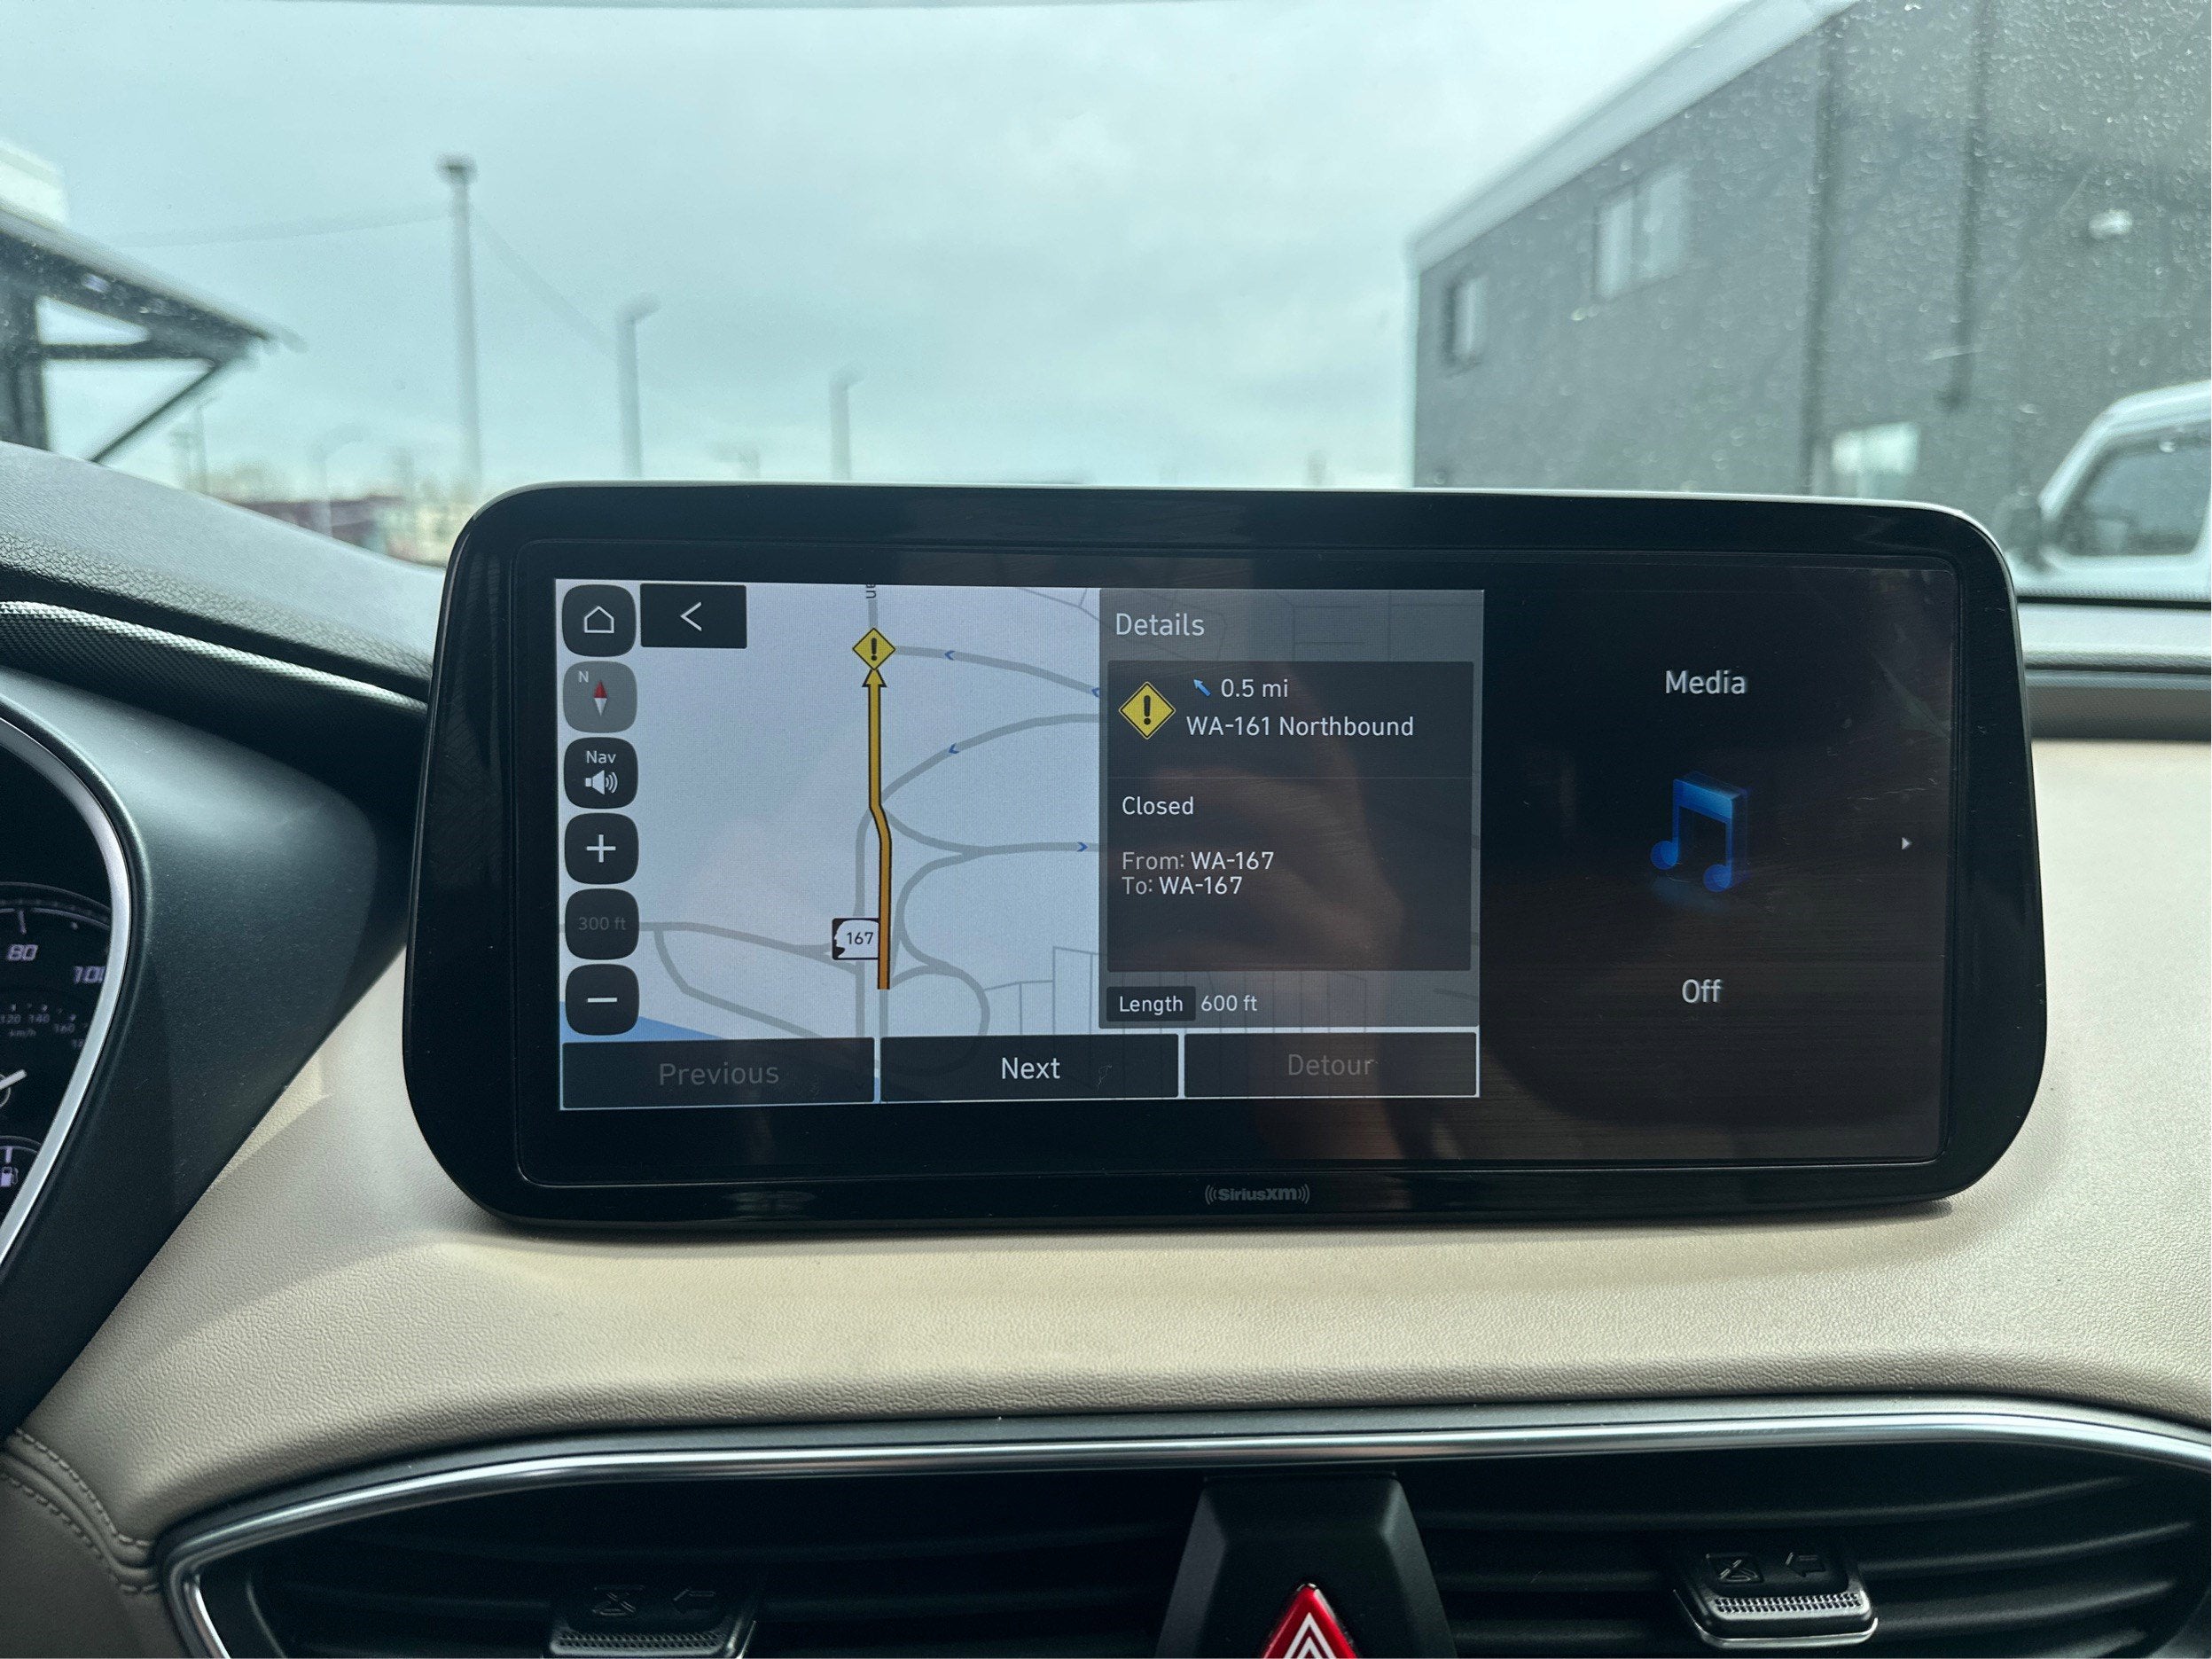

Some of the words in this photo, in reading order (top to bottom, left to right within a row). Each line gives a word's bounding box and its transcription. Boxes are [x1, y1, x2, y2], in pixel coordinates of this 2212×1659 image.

[1114, 610, 1205, 637] Details
[577, 669, 590, 684] N
[1665, 669, 1747, 696] Media
[1221, 678, 1255, 699] 0.5
[1262, 678, 1289, 699] mi
[1185, 715, 1270, 737] WA-161
[1279, 715, 1414, 738] Northbound
[586, 749, 617, 765] Nav
[1122, 795, 1194, 817] Closed
[1122, 851, 1185, 872] From:
[1191, 851, 1275, 871] WA-167
[1122, 876, 1153, 895] To:
[1159, 875, 1243, 896] WA-167
[577, 916, 610, 932] 300
[614, 915, 627, 931] ft
[846, 931, 874, 946] 167
[7, 944, 38, 961] 80
[1681, 978, 1723, 1005] Off
[1120, 994, 1184, 1017] Length
[1200, 993, 1239, 1013] 600
[1243, 993, 1259, 1013] ft
[659, 1060, 780, 1086] Previous
[1001, 1055, 1061, 1081] Next
[1287, 1053, 1374, 1076] Detour
